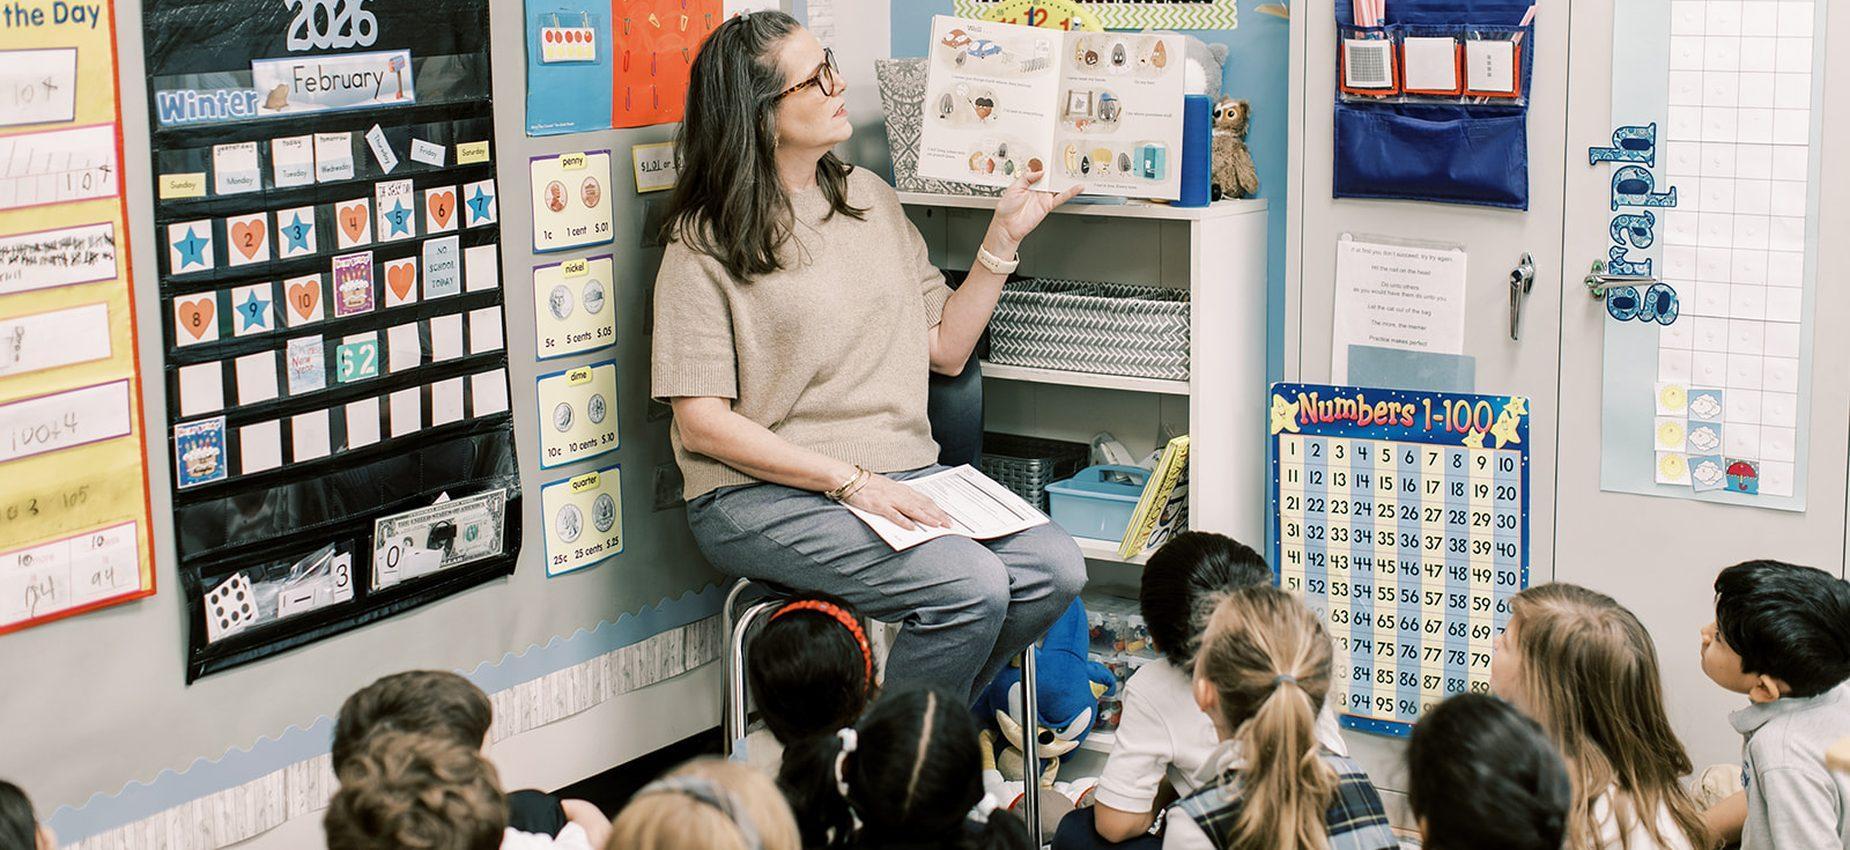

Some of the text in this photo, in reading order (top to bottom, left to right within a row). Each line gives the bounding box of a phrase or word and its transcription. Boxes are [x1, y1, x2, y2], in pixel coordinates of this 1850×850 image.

[3, 1, 100, 29] the Day
[285, 0, 379, 52] 2026
[293, 65, 384, 100] February
[157, 89, 258, 126] Winter
[374, 134, 391, 165] Thursday
[419, 145, 437, 160] Friday
[462, 148, 485, 158] Saturday
[283, 169, 307, 179] Tuesday
[321, 165, 352, 173] Wednesday
[562, 157, 584, 168] penny
[169, 179, 197, 191] Sunday
[226, 176, 254, 187] Monday
[243, 231, 254, 247] 2
[292, 225, 302, 240] 3
[350, 217, 358, 231] 4
[395, 210, 403, 225] 5
[438, 203, 446, 218] 6
[475, 198, 484, 212] 7
[572, 226, 588, 236] cent
[1588, 122, 1679, 326] graph
[437, 246, 448, 255] NO
[428, 261, 455, 273] SCHOOL
[565, 262, 585, 274] nickel
[432, 277, 454, 289] TODAY
[192, 293, 311, 327] 8 9 10
[566, 334, 572, 344] 5
[573, 331, 592, 343] cents
[570, 371, 587, 381] dime
[1298, 391, 1495, 434] Numbers 1-100
[569, 442, 578, 452] 10
[579, 438, 598, 450] cents
[1312, 443, 1320, 457] 2
[1336, 445, 1344, 458] 3
[1358, 447, 1367, 460] 4
[1382, 449, 1390, 462] 5
[1405, 451, 1414, 464] 6
[1429, 453, 1437, 465] 7
[1453, 454, 1461, 468] 8
[1477, 456, 1486, 469] 9
[1500, 458, 1513, 472] 10
[572, 476, 597, 490] quarter
[1289, 469, 1516, 501] 11 12 13 14 15 16 17 18 19 20
[1287, 496, 1516, 529] 21 22 23 24 25 26 27 28 29 30
[574, 549, 584, 560] 25
[585, 543, 603, 555] cents
[1288, 523, 1516, 557] 31 32 33 34 35 36 37 38 39 40
[336, 564, 349, 588] 3
[1288, 551, 1516, 586] 41 42 43 44 45 46 47 48 49 50
[1288, 577, 1491, 611] 51 52 53 54 55 56 57 58 59
[1332, 609, 1348, 623] 63
[1354, 612, 1371, 626] 64
[1377, 615, 1394, 629] 65
[1400, 617, 1419, 631] 66
[1425, 620, 1442, 633] 67
[1448, 622, 1466, 637] 68
[1472, 625, 1490, 639] 69
[1354, 639, 1371, 653] 74
[1378, 642, 1394, 656] 75
[1401, 645, 1417, 659] 76
[1424, 647, 1442, 661] 77
[1449, 650, 1465, 665] 78
[1472, 653, 1490, 667] 79
[1353, 666, 1370, 681] 84
[1377, 669, 1393, 684] 85
[1400, 672, 1417, 687] 86
[1424, 675, 1441, 689] 87
[1447, 677, 1465, 693] 88
[1471, 681, 1490, 696] 89
[1352, 694, 1370, 709] 94
[1376, 697, 1393, 712] 95
[1400, 700, 1417, 714] 96
